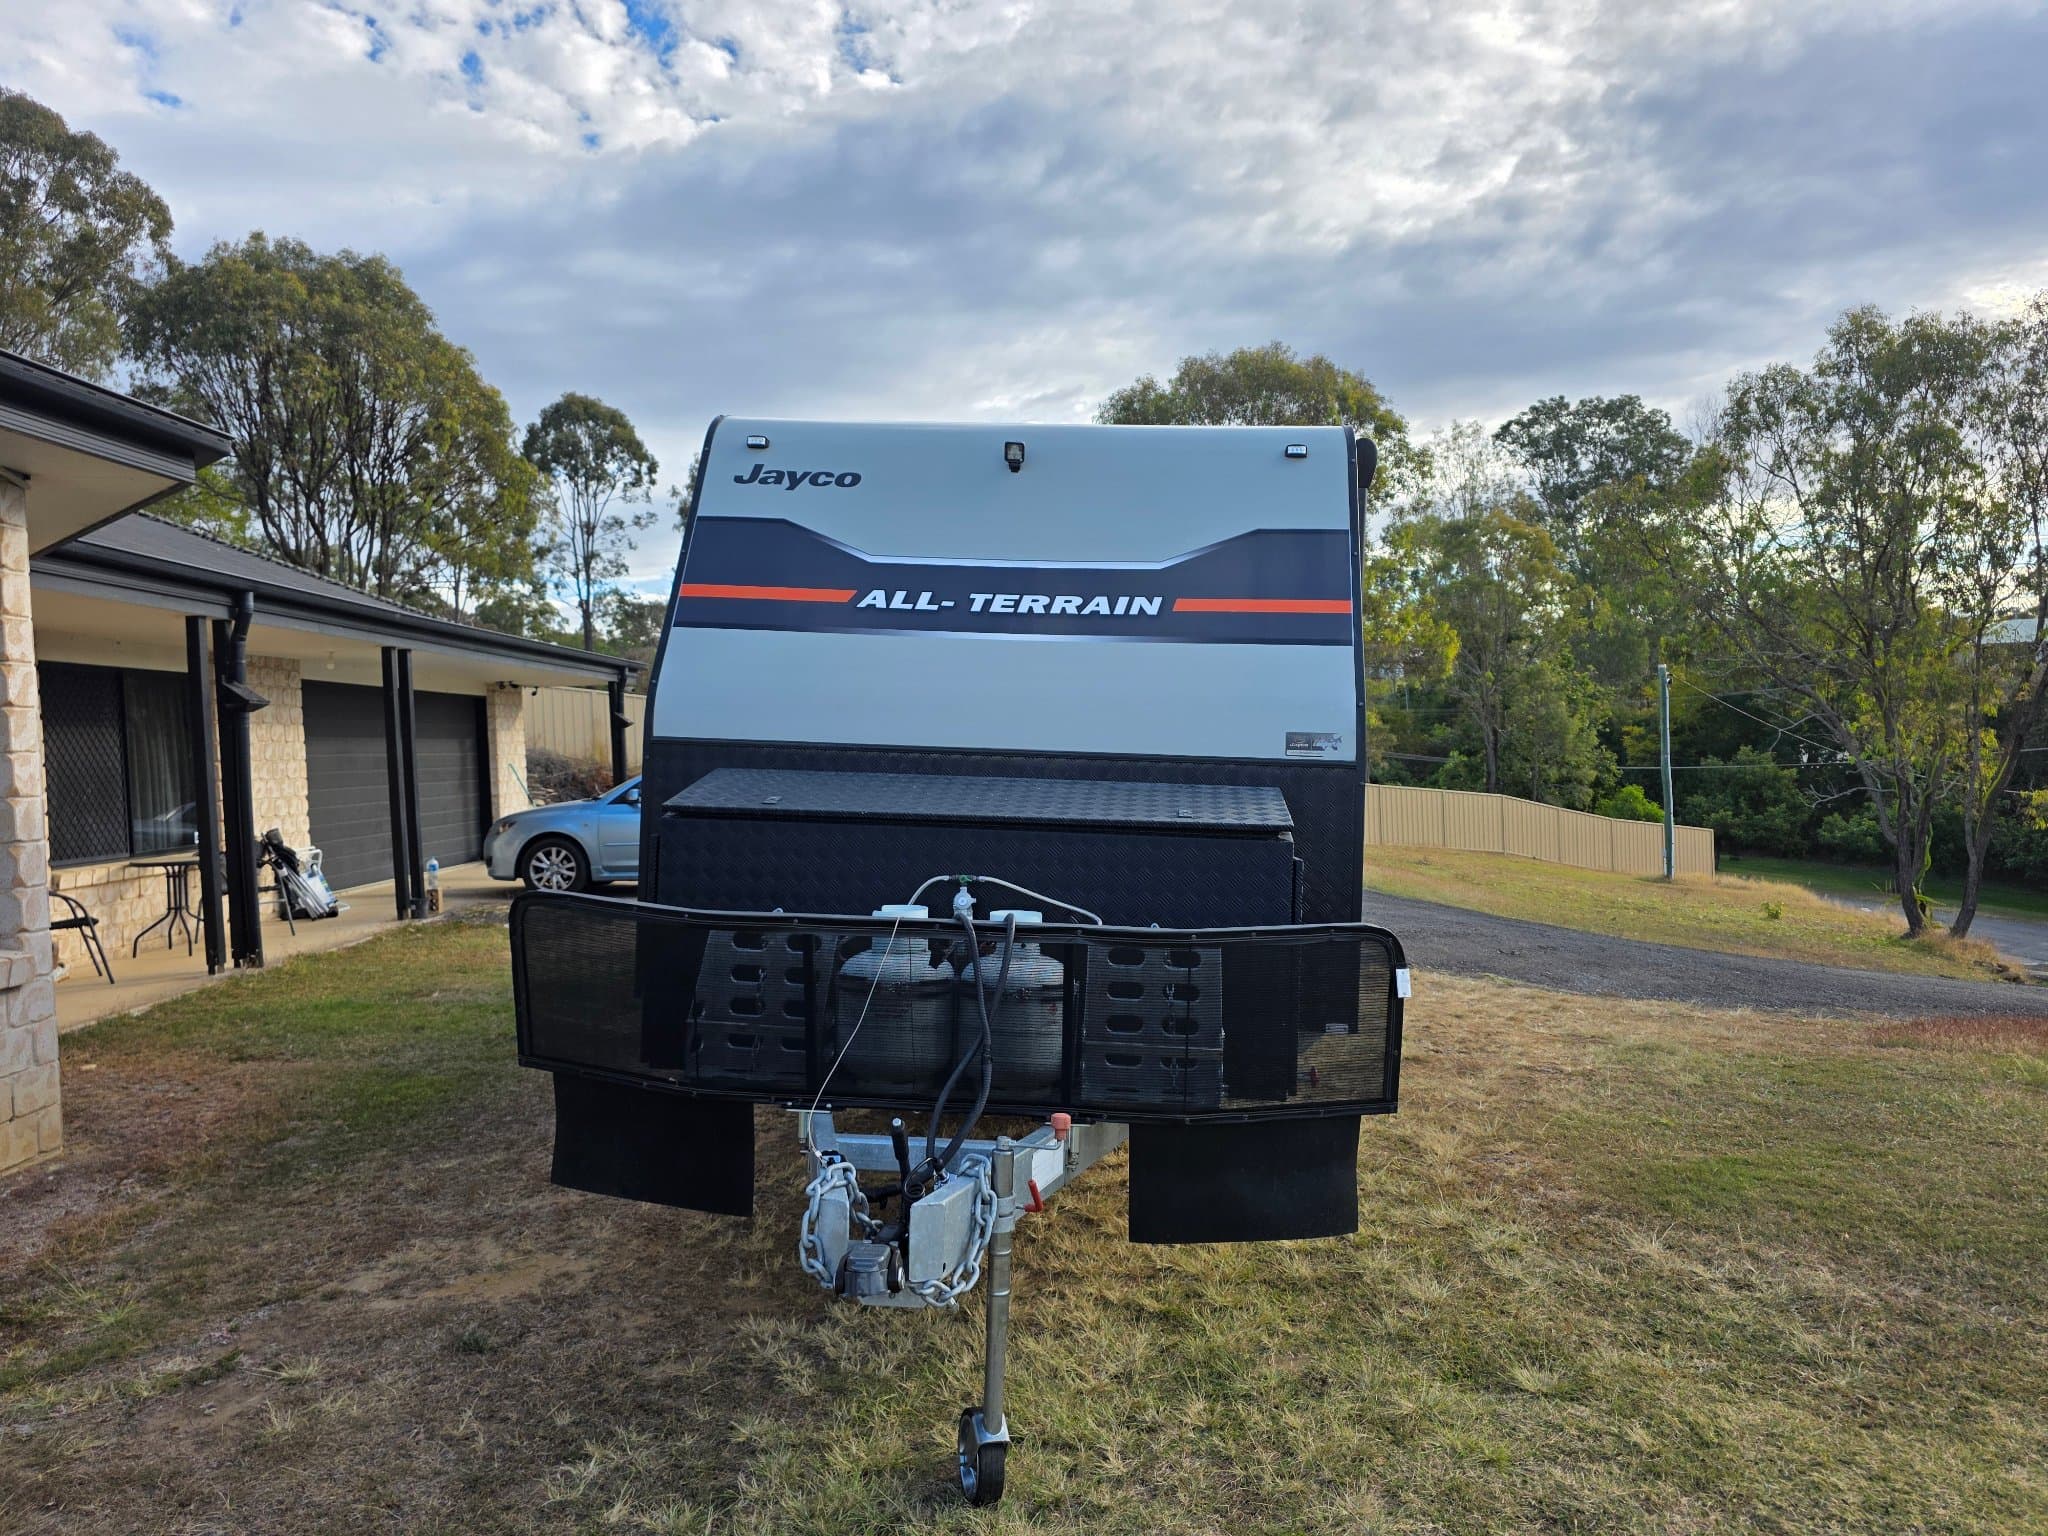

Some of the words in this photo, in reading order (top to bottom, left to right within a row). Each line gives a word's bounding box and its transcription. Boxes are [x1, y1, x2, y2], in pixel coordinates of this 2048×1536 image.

[733, 463, 862, 491] Jayco
[856, 589, 955, 611] ALL-
[968, 593, 1162, 616] TERRAIN
